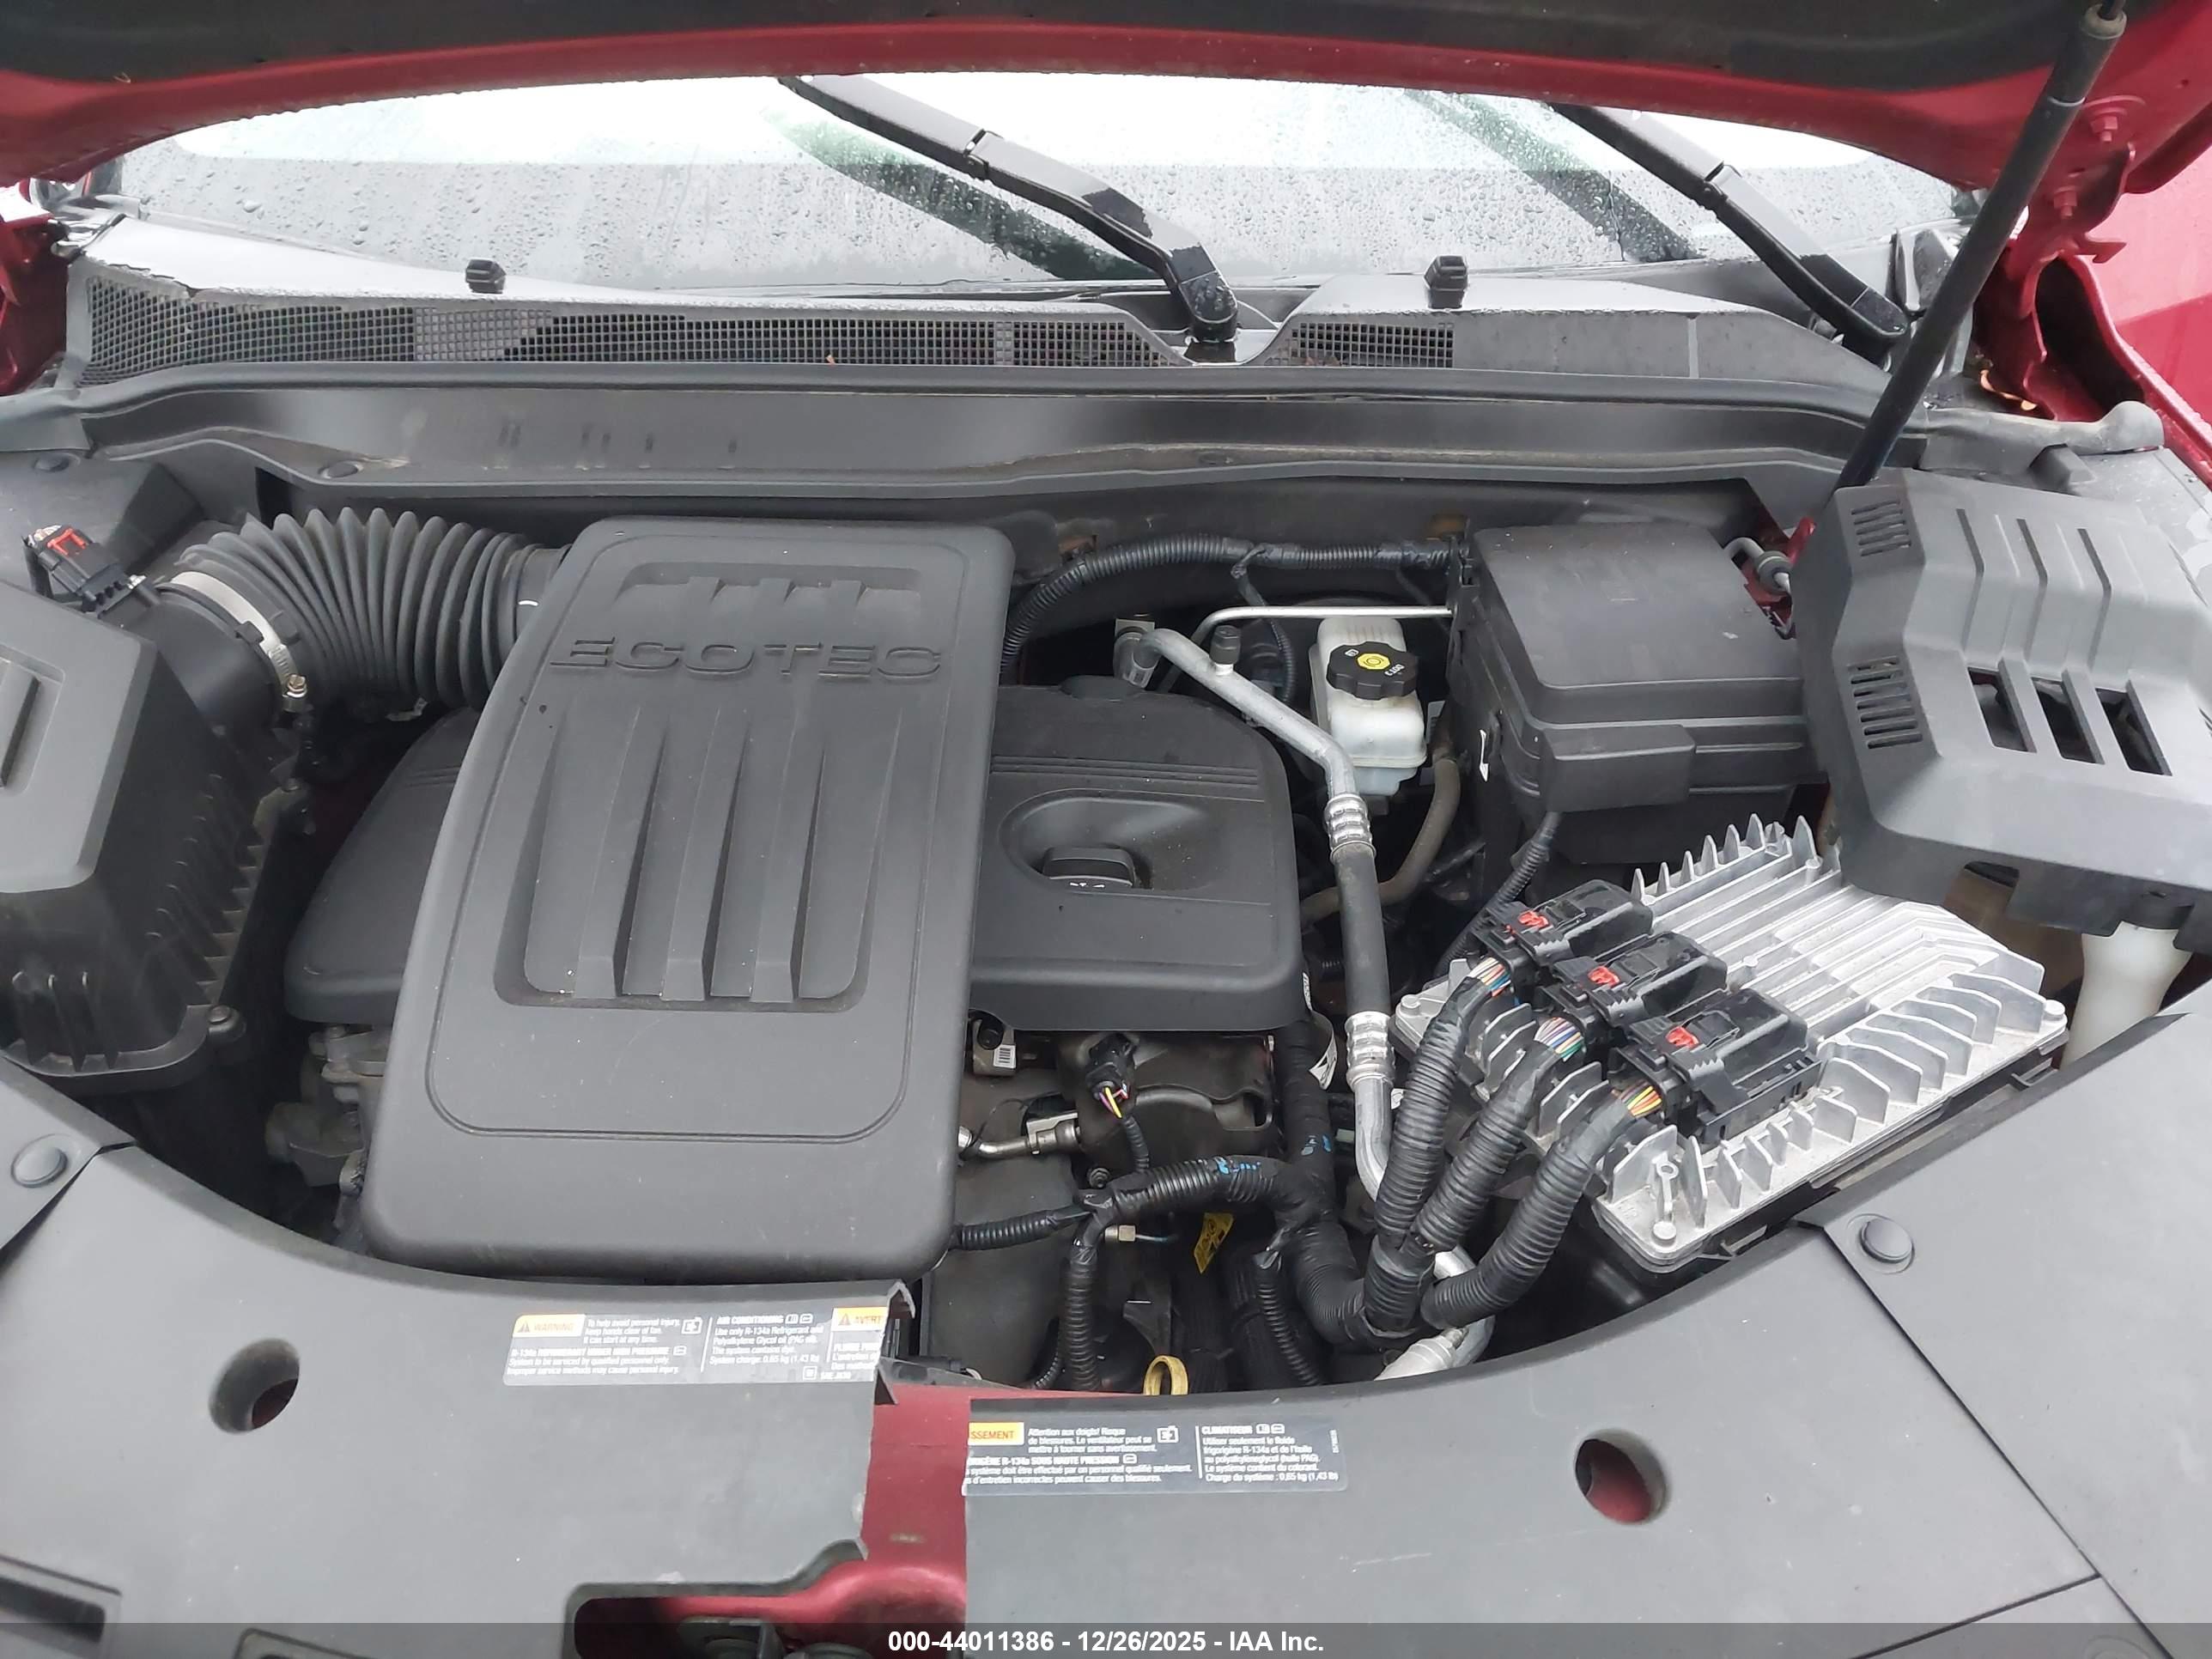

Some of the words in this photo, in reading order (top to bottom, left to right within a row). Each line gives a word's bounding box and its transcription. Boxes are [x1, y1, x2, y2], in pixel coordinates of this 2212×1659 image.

[550, 637, 941, 678] ECOTEC
[732, 1316, 783, 1324] CONDITIONING
[533, 1322, 577, 1333] WARNING
[970, 1431, 1015, 1439] SSEMENT
